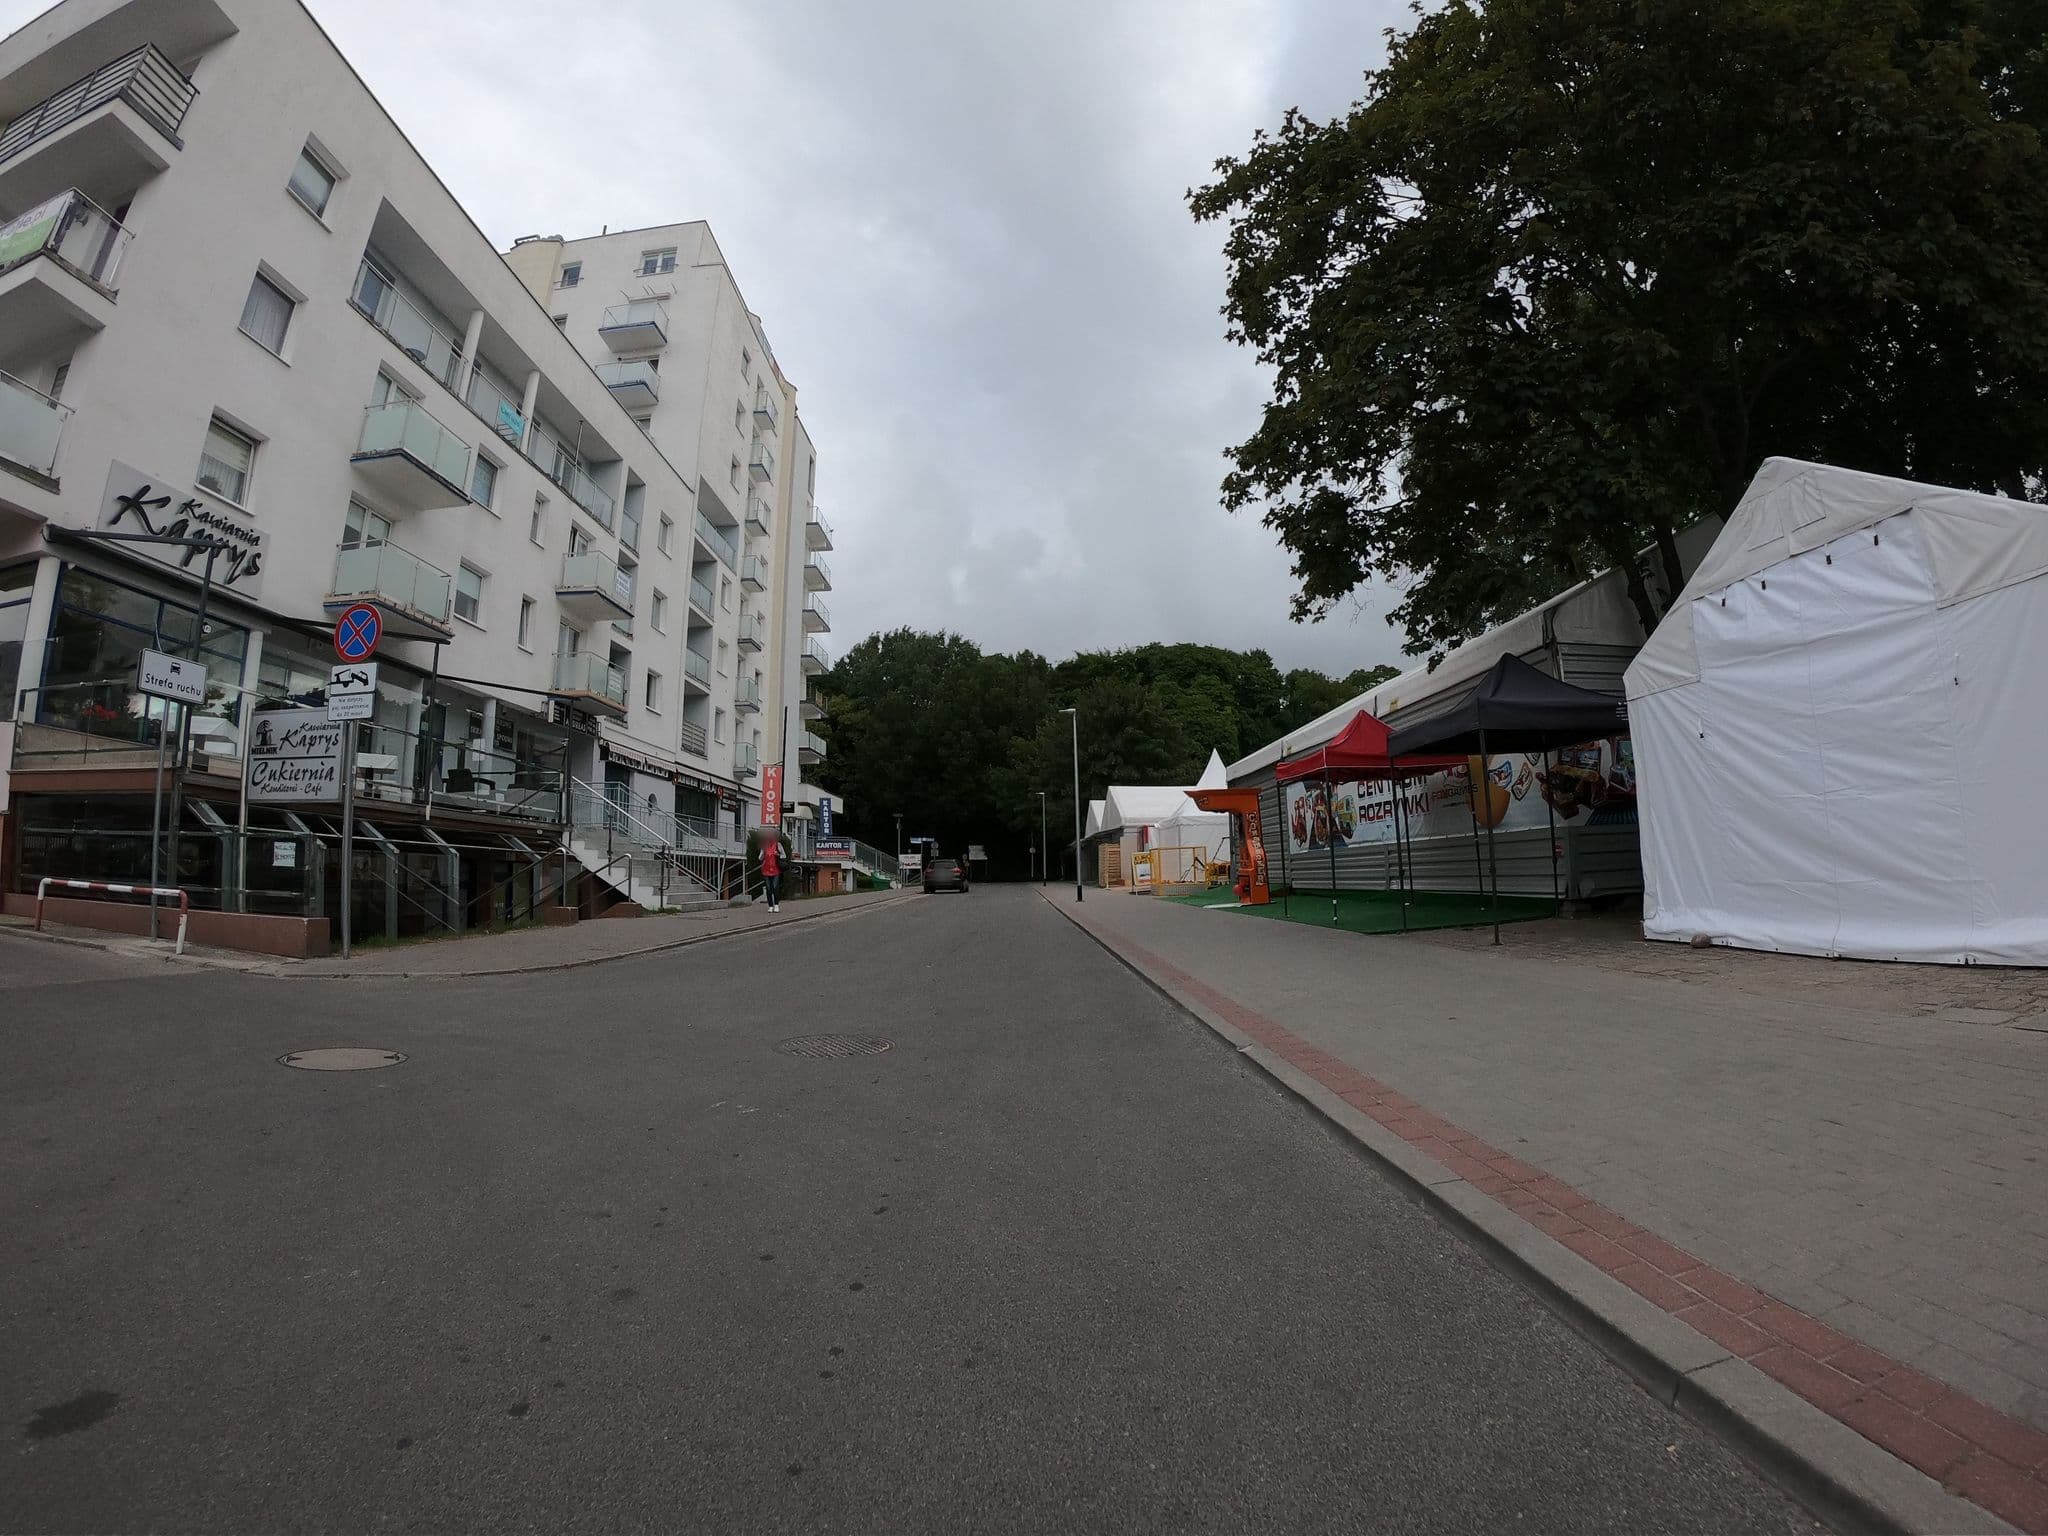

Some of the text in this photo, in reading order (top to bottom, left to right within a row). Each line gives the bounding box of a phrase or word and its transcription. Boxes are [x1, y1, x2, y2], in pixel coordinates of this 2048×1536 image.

[109, 484, 262, 586] Kaprys
[178, 498, 261, 547] Kawiarnia
[145, 673, 201, 697] Strefa ruchu
[279, 729, 339, 754] Kaprys
[299, 721, 340, 733] Kawiarnia
[251, 760, 334, 786] Cukiernia
[765, 767, 777, 824] KIOSK
[822, 800, 830, 834] KANTOR
